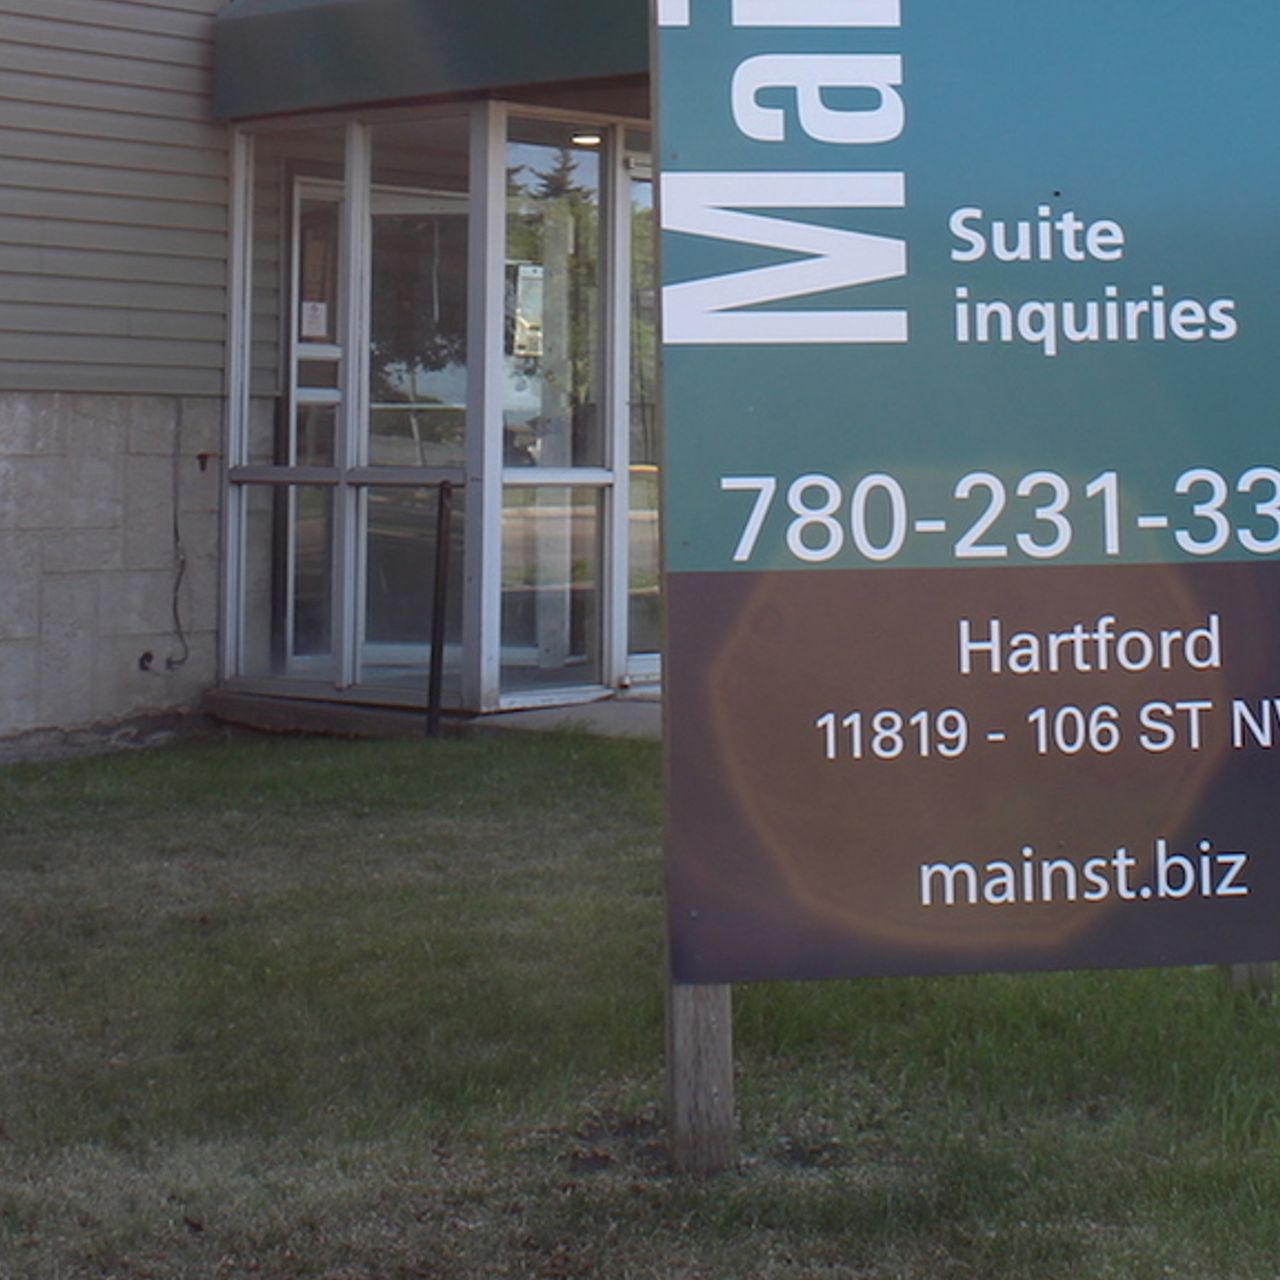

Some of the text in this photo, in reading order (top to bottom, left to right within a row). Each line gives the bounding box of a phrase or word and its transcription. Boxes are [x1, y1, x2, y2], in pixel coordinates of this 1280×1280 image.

[948, 205, 1125, 262] Suite
[955, 285, 1239, 356] inquiries
[959, 614, 1222, 674] Hartford
[816, 709, 969, 759] 11819
[987, 733, 1005, 742] -
[1028, 705, 1120, 754] 106
[1139, 701, 1213, 751] ST
[921, 839, 1248, 906] mainst.biz
